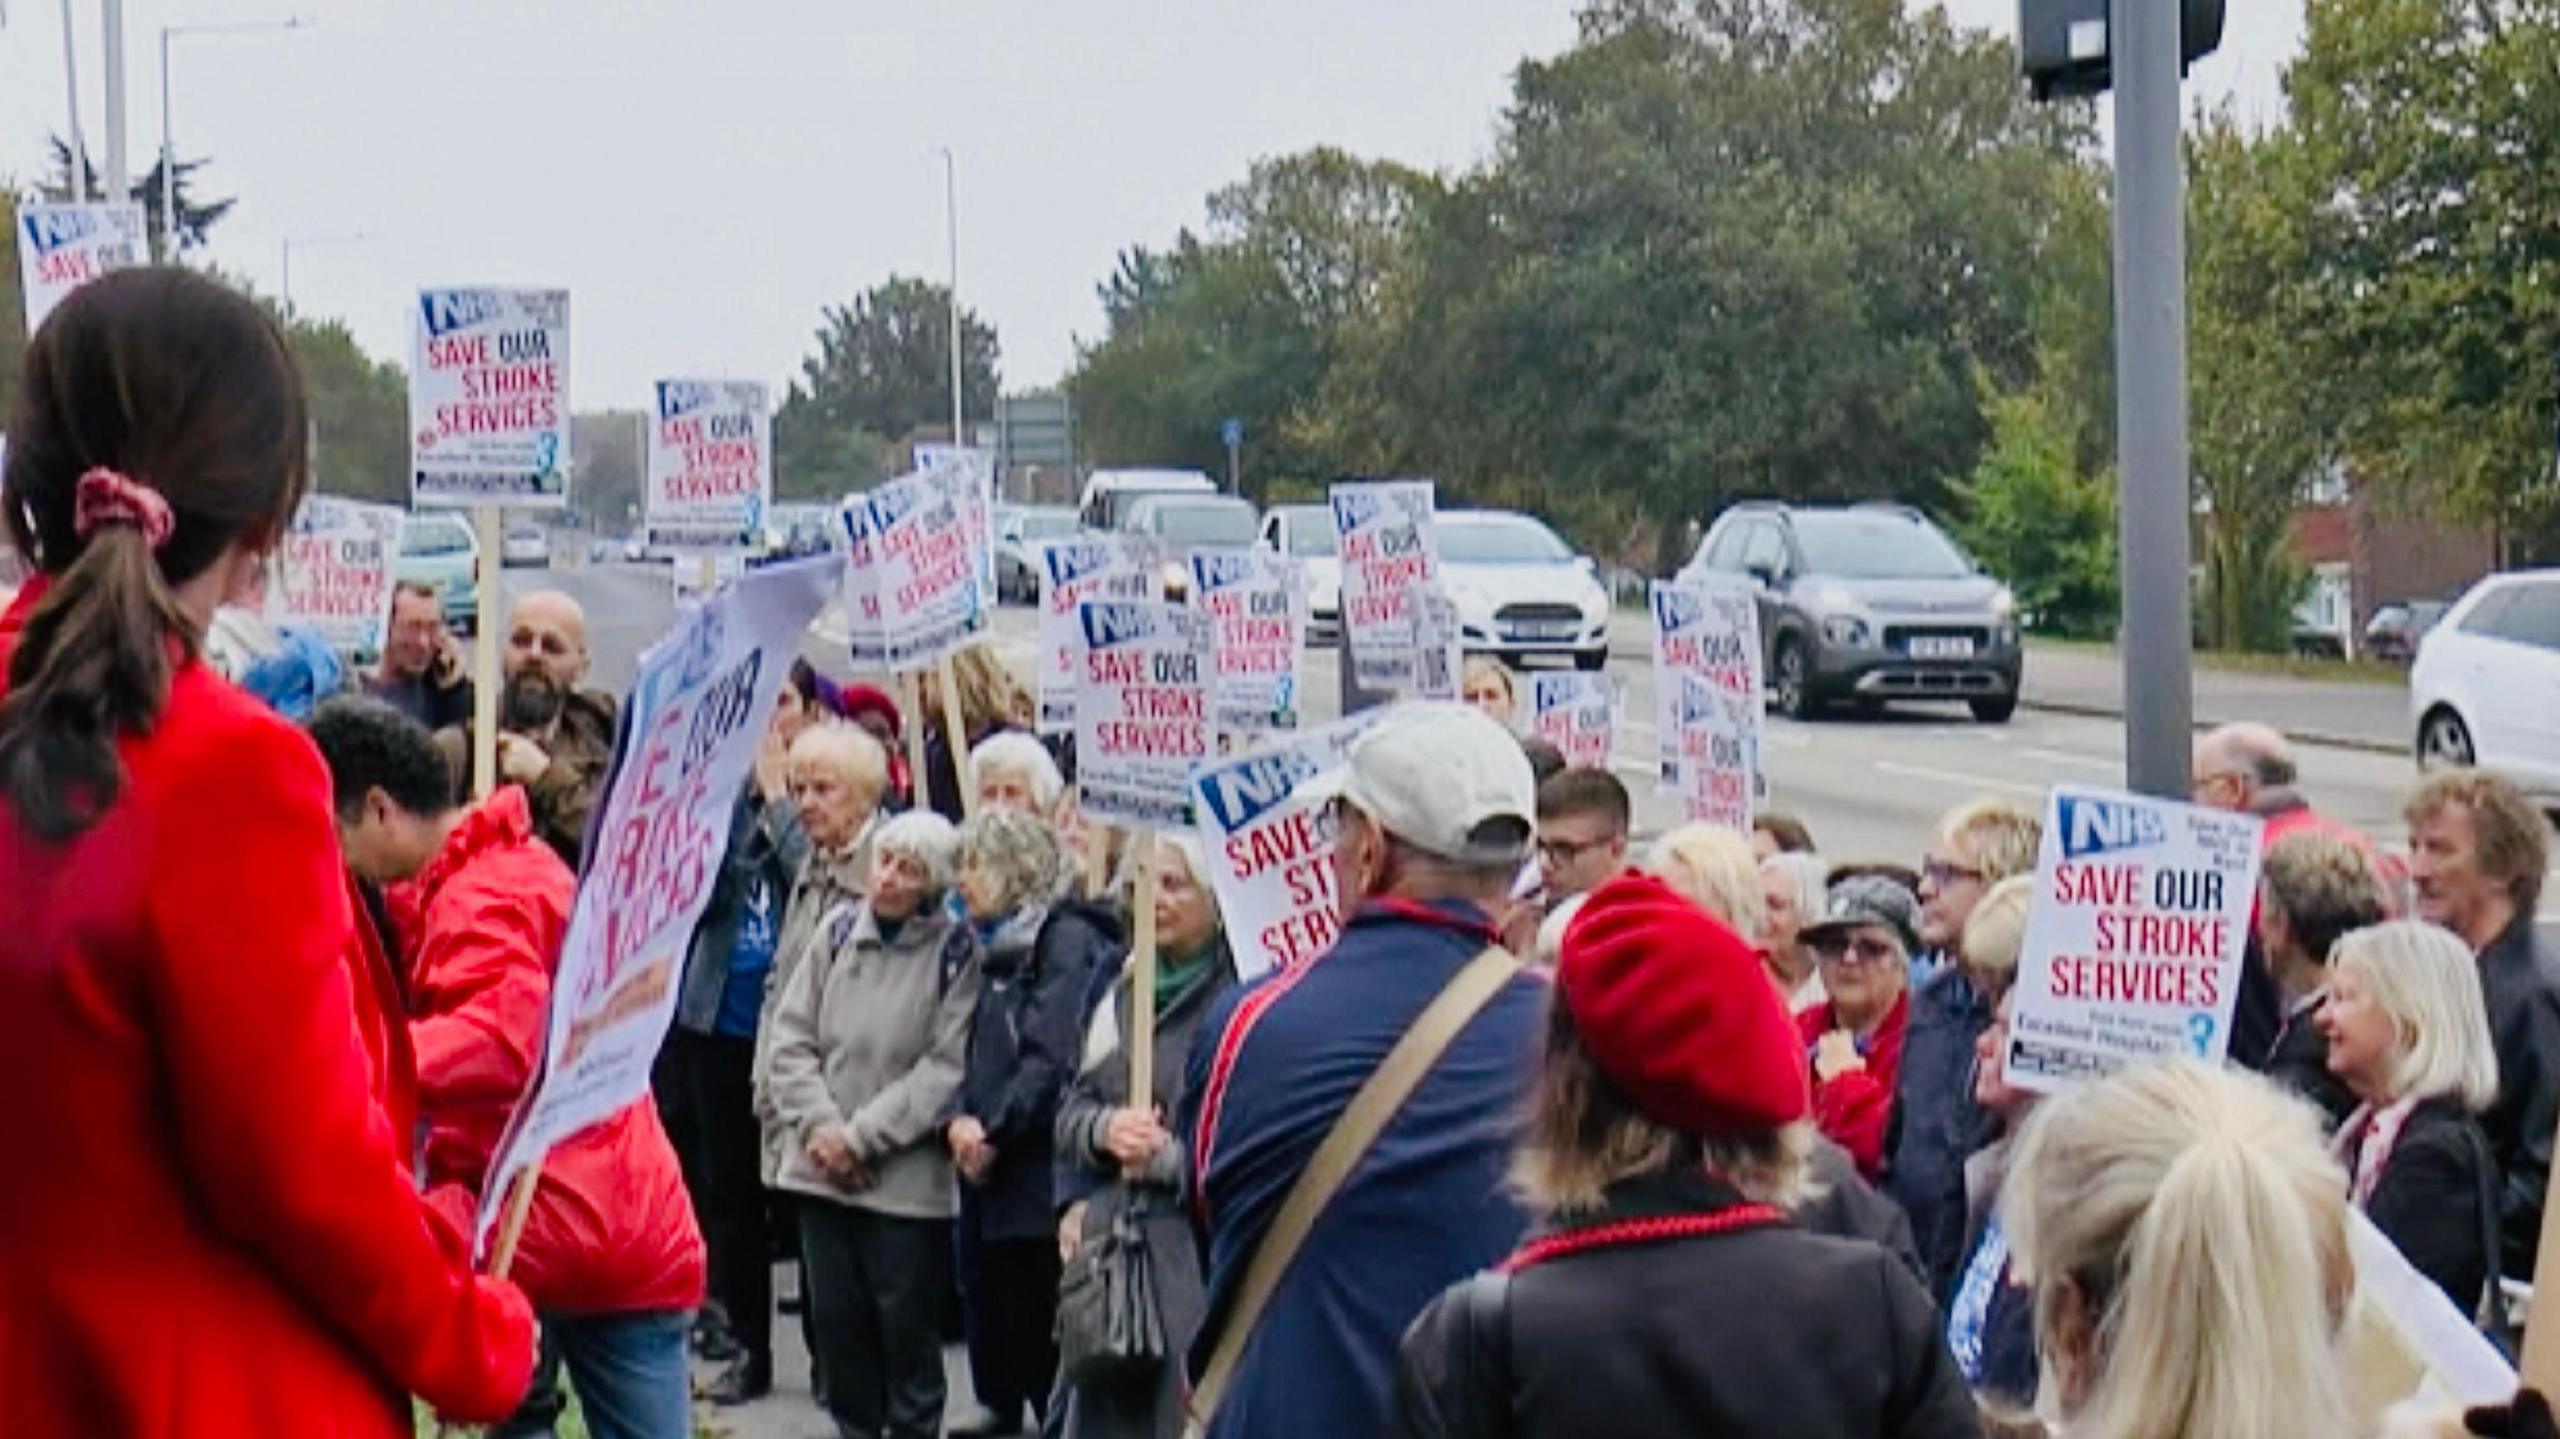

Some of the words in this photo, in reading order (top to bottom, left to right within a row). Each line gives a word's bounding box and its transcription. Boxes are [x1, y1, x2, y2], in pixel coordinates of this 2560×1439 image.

[428, 334, 488, 369] SAVE
[499, 328, 550, 361] OUR
[462, 363, 560, 398] STROKE
[437, 398, 558, 437] SERVICES
[711, 412, 753, 440] OUR
[1088, 651, 1147, 684] SAVE
[1153, 650, 1198, 684] OUR
[1122, 689, 1207, 720] STROKE
[1097, 721, 1206, 758] SERVICES
[1226, 808, 1316, 881] SAVE
[2060, 797, 2165, 857] NHS
[2055, 863, 2143, 907] SAVE
[2154, 870, 2223, 913] OUR
[2097, 911, 2230, 962] STROKE
[2050, 957, 2219, 1008] SERVICES
